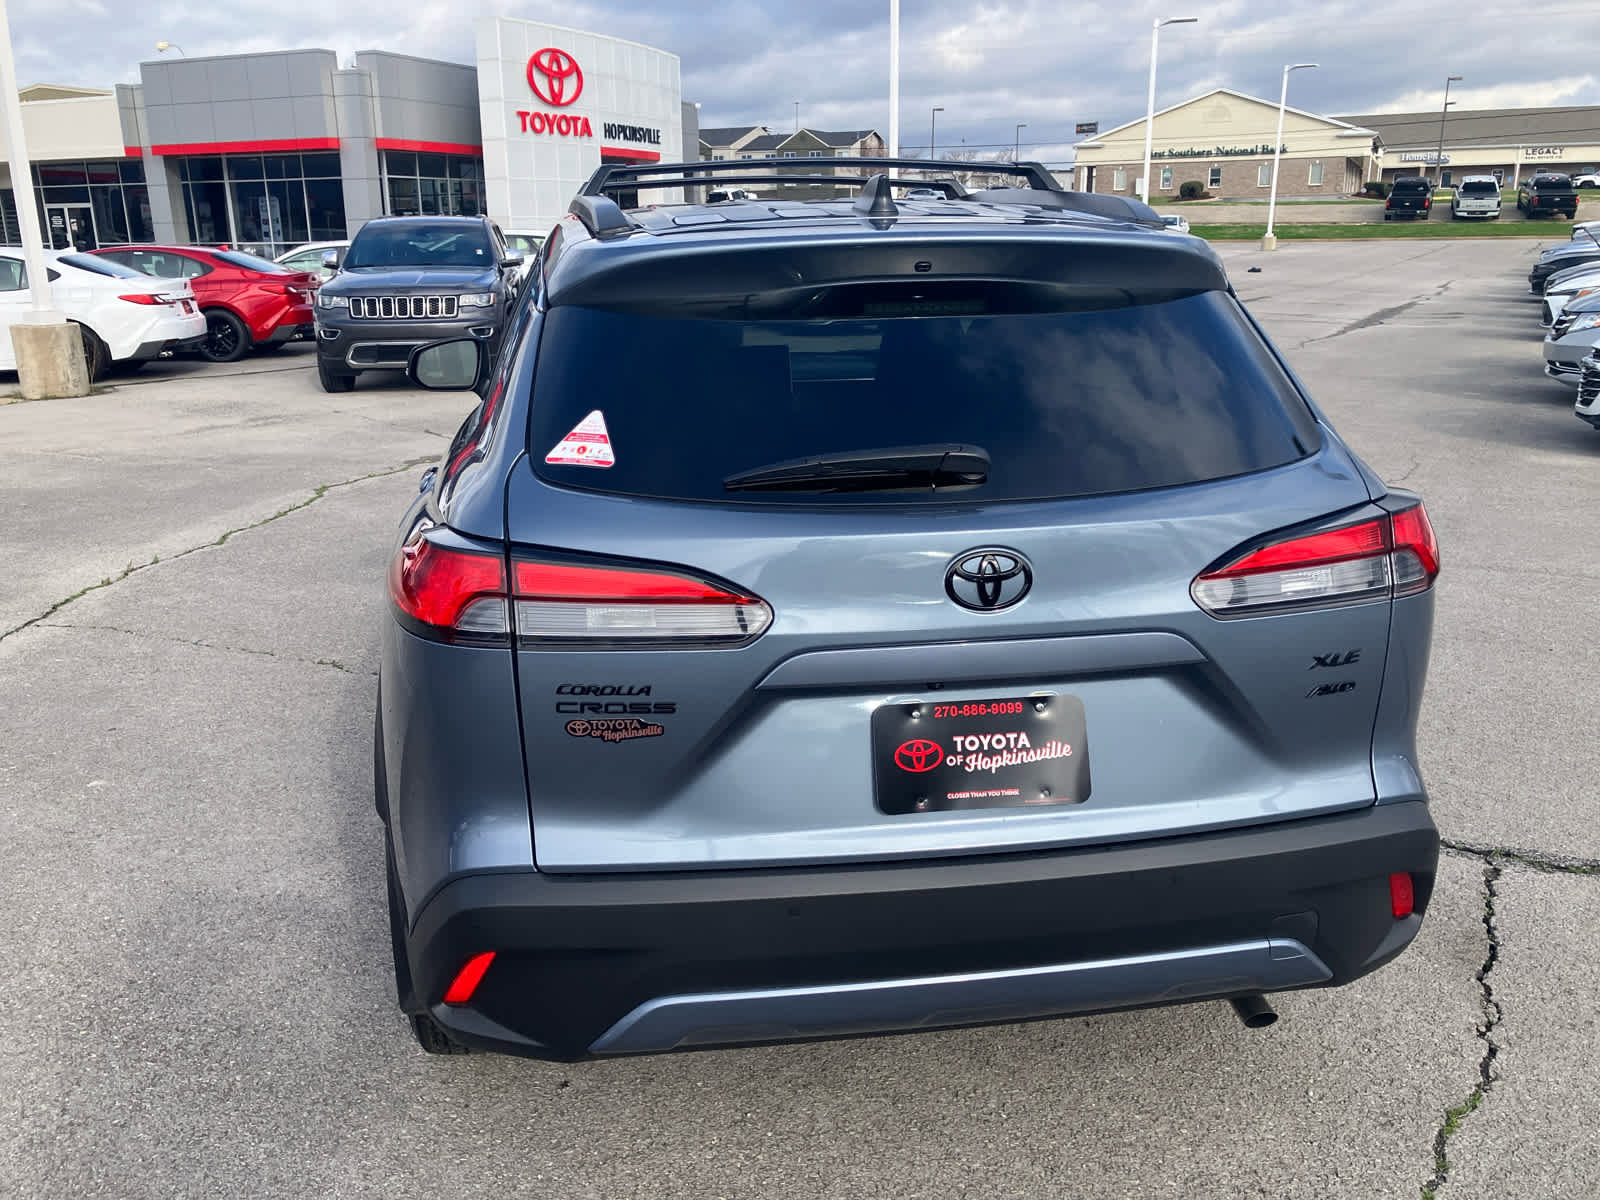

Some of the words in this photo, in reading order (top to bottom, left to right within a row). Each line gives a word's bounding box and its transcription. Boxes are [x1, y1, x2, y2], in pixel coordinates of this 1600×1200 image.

[516, 111, 592, 137] TOYOTA
[603, 122, 661, 145] HOPKINSVILLE
[1167, 147, 1213, 159] Southern
[1215, 144, 1258, 157] National
[1262, 143, 1289, 155] Bak
[1525, 146, 1564, 156] LEGACY
[1309, 649, 1361, 670] XLE
[556, 684, 652, 697] COROLLA
[556, 701, 677, 714] CROSS
[934, 702, 1022, 718] 270-886-9099
[590, 719, 641, 730] TOYOTA
[602, 725, 663, 742] Hopkinsville
[953, 732, 1030, 752] TOYOTA
[946, 755, 964, 767] OF
[964, 740, 1072, 774] Hopkinsville
[947, 791, 970, 800] CLOSER
[970, 790, 987, 798] THAN
[988, 789, 1001, 797] YOU
